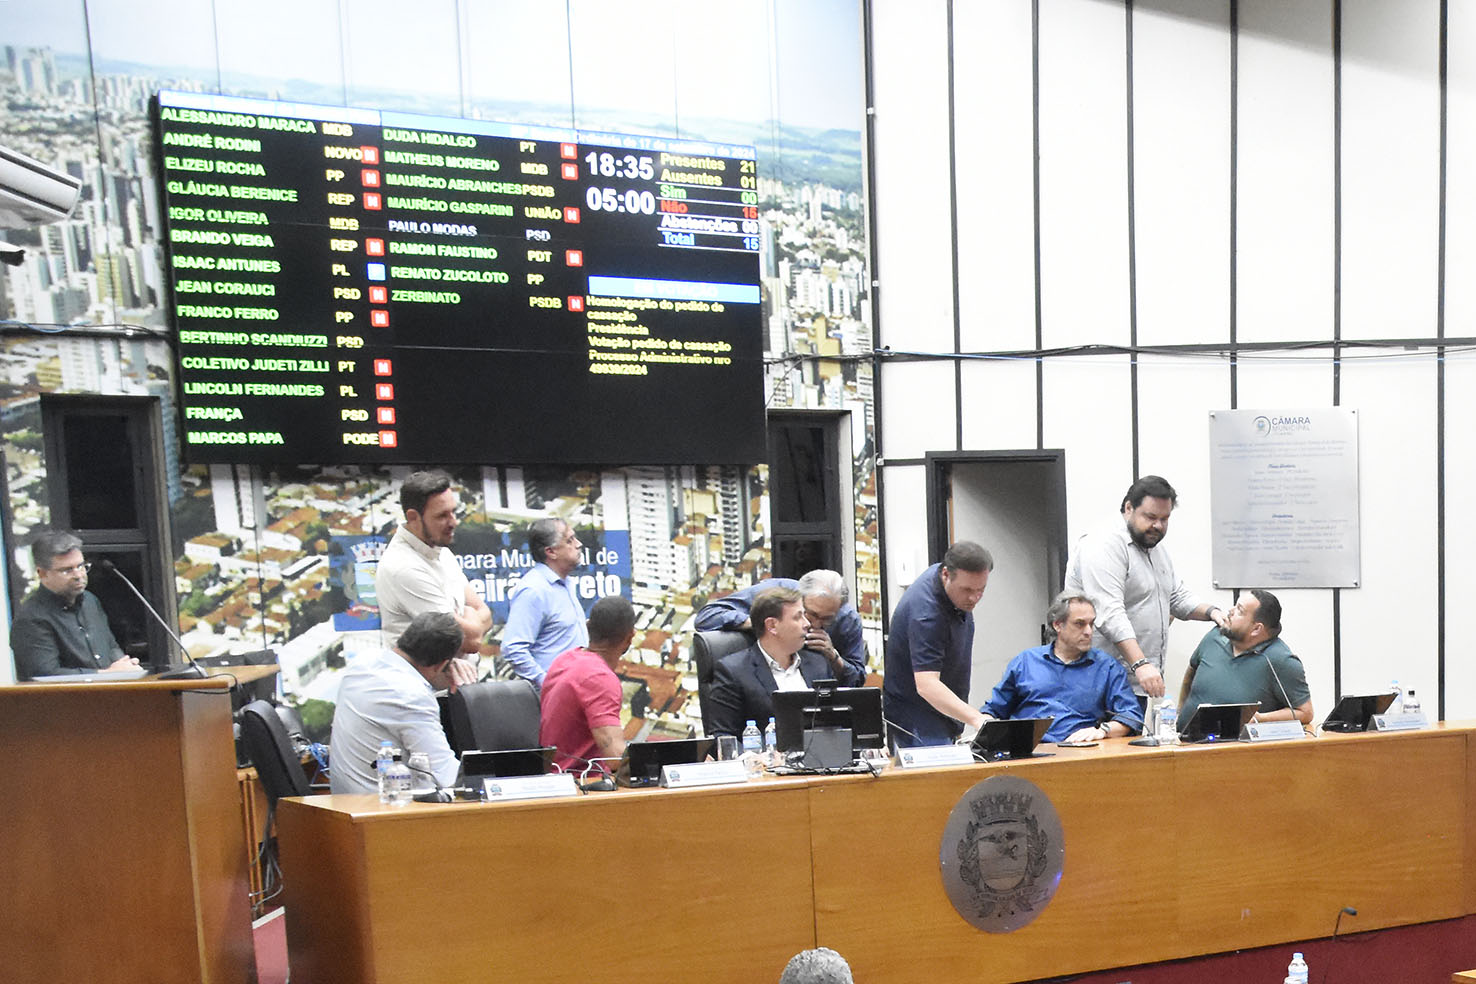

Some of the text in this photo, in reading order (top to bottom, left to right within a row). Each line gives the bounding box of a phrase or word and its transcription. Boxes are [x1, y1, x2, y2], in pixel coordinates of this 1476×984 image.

[161, 107, 256, 128] ALESSANDRO
[322, 123, 352, 136] MDB
[164, 131, 261, 152] ANDRÉ RODINI
[384, 129, 476, 148] DUDA HIDALGO
[640, 137, 650, 149] 17
[325, 146, 362, 160] NOVO
[520, 141, 536, 153] PT
[166, 156, 265, 176] ELIZEU ROCHA
[384, 150, 499, 171] MATHEUS MORENO
[585, 152, 654, 180] 18:35
[661, 152, 725, 171] Presentes
[740, 160, 755, 173] 21
[521, 162, 548, 175] MDB
[326, 170, 344, 182] PP
[661, 169, 723, 186] Ausentes
[741, 176, 755, 189] 01
[168, 179, 298, 202] GLÁUCIA BERENICE
[386, 174, 522, 195] MAURÍCIO ABRANCHES
[522, 184, 555, 197] PSDB
[660, 185, 686, 199] Sim
[741, 192, 757, 204] 00
[328, 193, 355, 206] REP
[388, 197, 513, 216] MAURÍCIO GASPARINI
[586, 186, 655, 214] 05:00
[661, 200, 688, 213] Não
[170, 206, 269, 225] IGOR OLIVEIRA
[525, 206, 562, 220] UNIÃO
[743, 207, 758, 219] 15
[329, 217, 359, 231] MDB
[389, 220, 477, 237] PAULO MODAS
[661, 216, 738, 233] Abstenções
[742, 221, 758, 234] 00
[170, 229, 274, 247] BRANDO VEIGA
[526, 229, 550, 241] PSD
[662, 231, 695, 246] Total
[330, 239, 358, 252] REP
[389, 242, 498, 259] RAMON FAUSTINO
[743, 237, 758, 250] 15
[527, 250, 552, 262] PDT
[173, 256, 280, 273] ISAAC ANTUNES
[332, 264, 350, 276] PL
[391, 266, 442, 280] RENATO
[443, 269, 509, 284] ZUCOLOTO
[527, 274, 544, 285] PP
[175, 280, 275, 296] JEAN CORAUCI
[334, 287, 361, 300] PSD
[392, 290, 461, 304] ZERBINATO
[530, 297, 562, 308] PSDB
[586, 295, 725, 312] Homologação do pedido de
[177, 305, 279, 320] FRANCO FERRO
[335, 312, 354, 323] PP
[587, 310, 637, 322] cassação
[588, 322, 649, 335] Presidência
[180, 331, 328, 348] BERTINHO SCANDIUZZI
[336, 336, 364, 348] PSD
[588, 336, 731, 353] Votação pedido de cassação
[589, 350, 731, 364] Processo Administrativo nro
[182, 357, 330, 372] COLETIVO JUDETI ZILLI
[338, 361, 356, 373] PT
[184, 382, 324, 397] LINCOLN FERNANDES
[340, 385, 358, 397] PL
[186, 407, 243, 422] FRANÇA
[342, 409, 369, 422] PSD
[1272, 416, 1310, 426] CÂMARA
[188, 432, 284, 444] MARCOS PAPA
[343, 433, 379, 445] PODE
[596, 547, 618, 565] de
